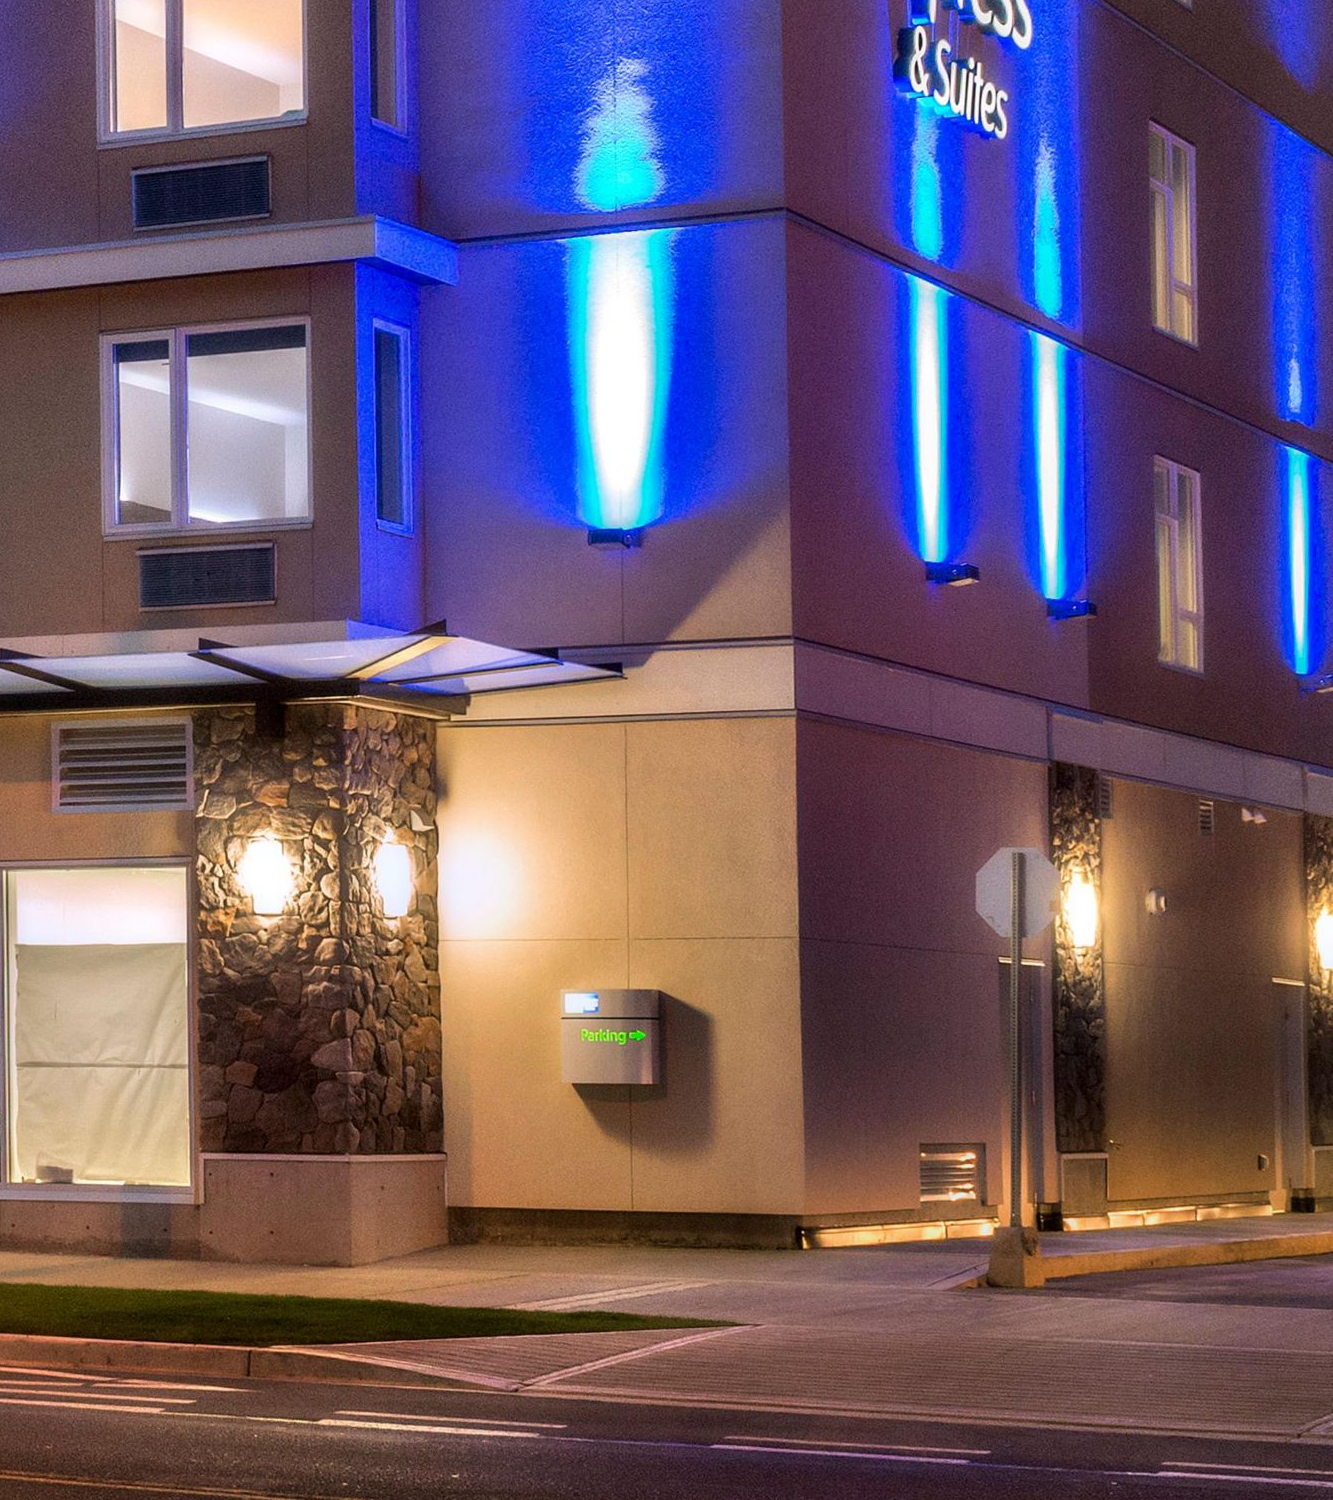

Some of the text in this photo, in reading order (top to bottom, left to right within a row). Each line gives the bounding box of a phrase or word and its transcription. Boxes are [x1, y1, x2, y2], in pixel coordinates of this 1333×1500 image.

[910, 25, 1009, 140] & Suites
[580, 1028, 627, 1045] Parking
